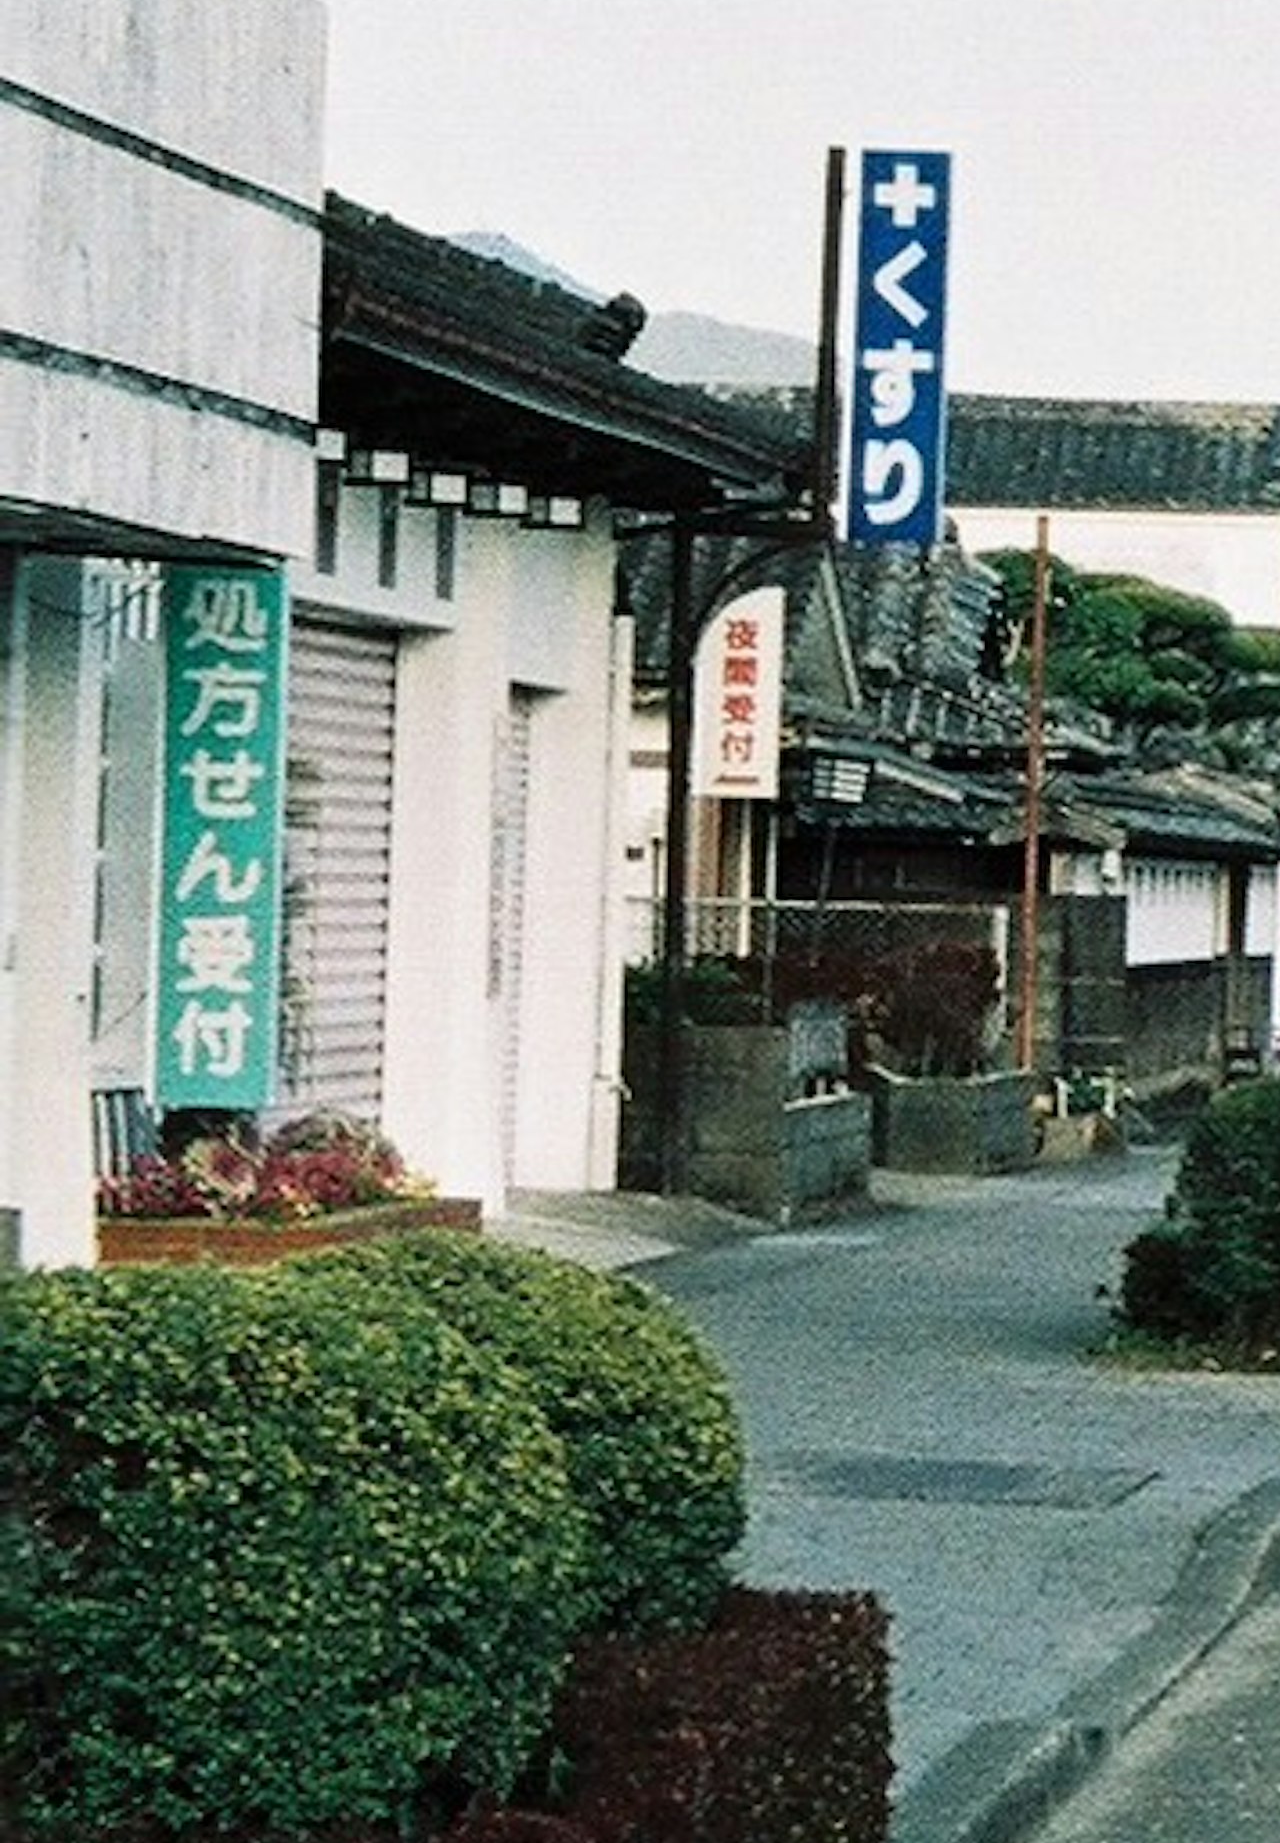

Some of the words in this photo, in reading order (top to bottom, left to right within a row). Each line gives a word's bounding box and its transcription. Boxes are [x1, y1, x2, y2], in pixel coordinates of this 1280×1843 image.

[862, 240, 935, 526] くすり
[173, 578, 268, 1078] 処方せん受付
